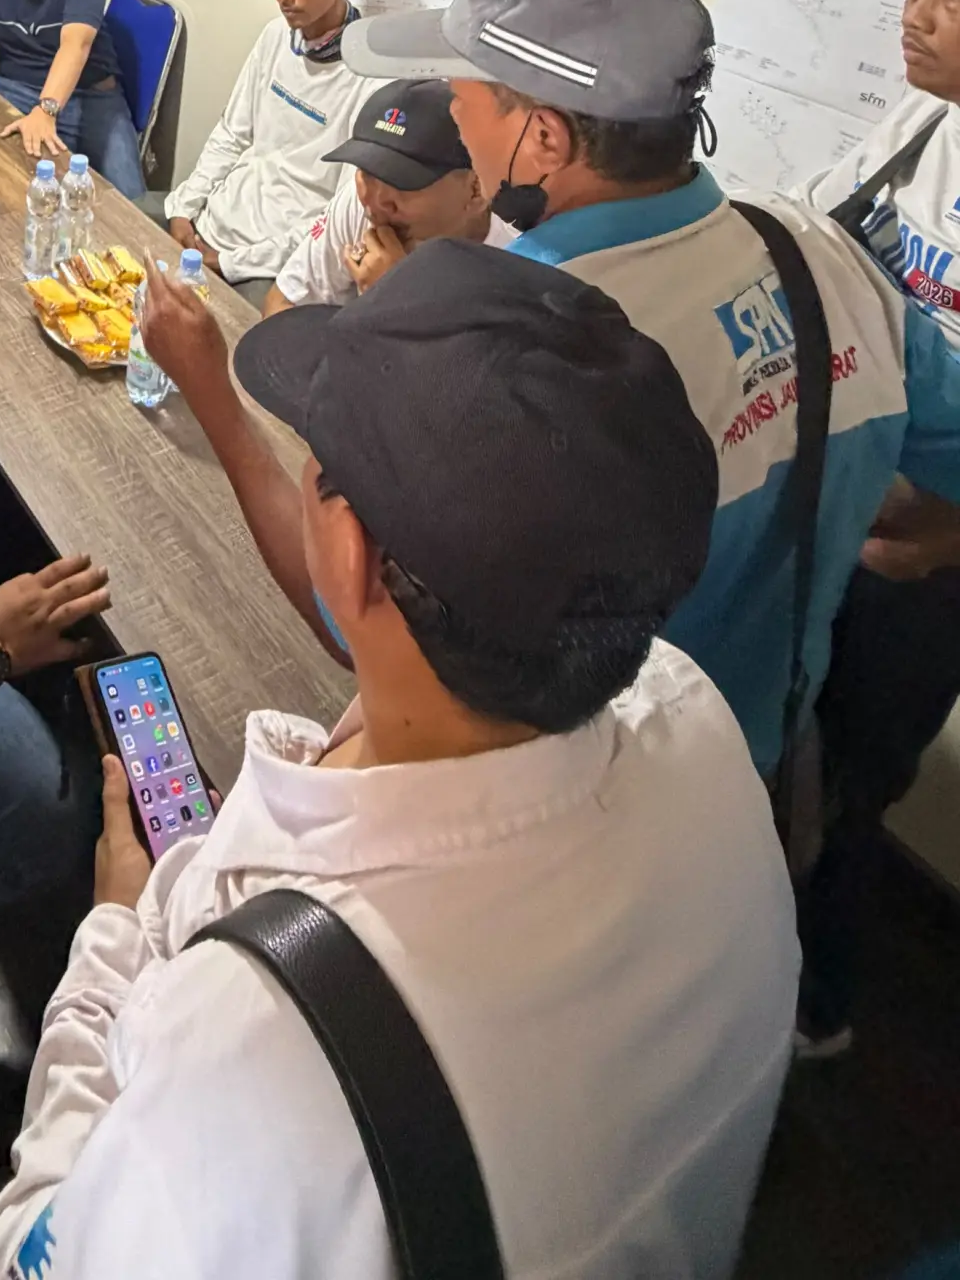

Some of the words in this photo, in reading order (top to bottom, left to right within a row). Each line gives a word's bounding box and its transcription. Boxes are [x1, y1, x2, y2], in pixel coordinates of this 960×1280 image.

[858, 91, 887, 109] sfm
[916, 276, 954, 308] 2026
[829, 345, 858, 382] RAT
